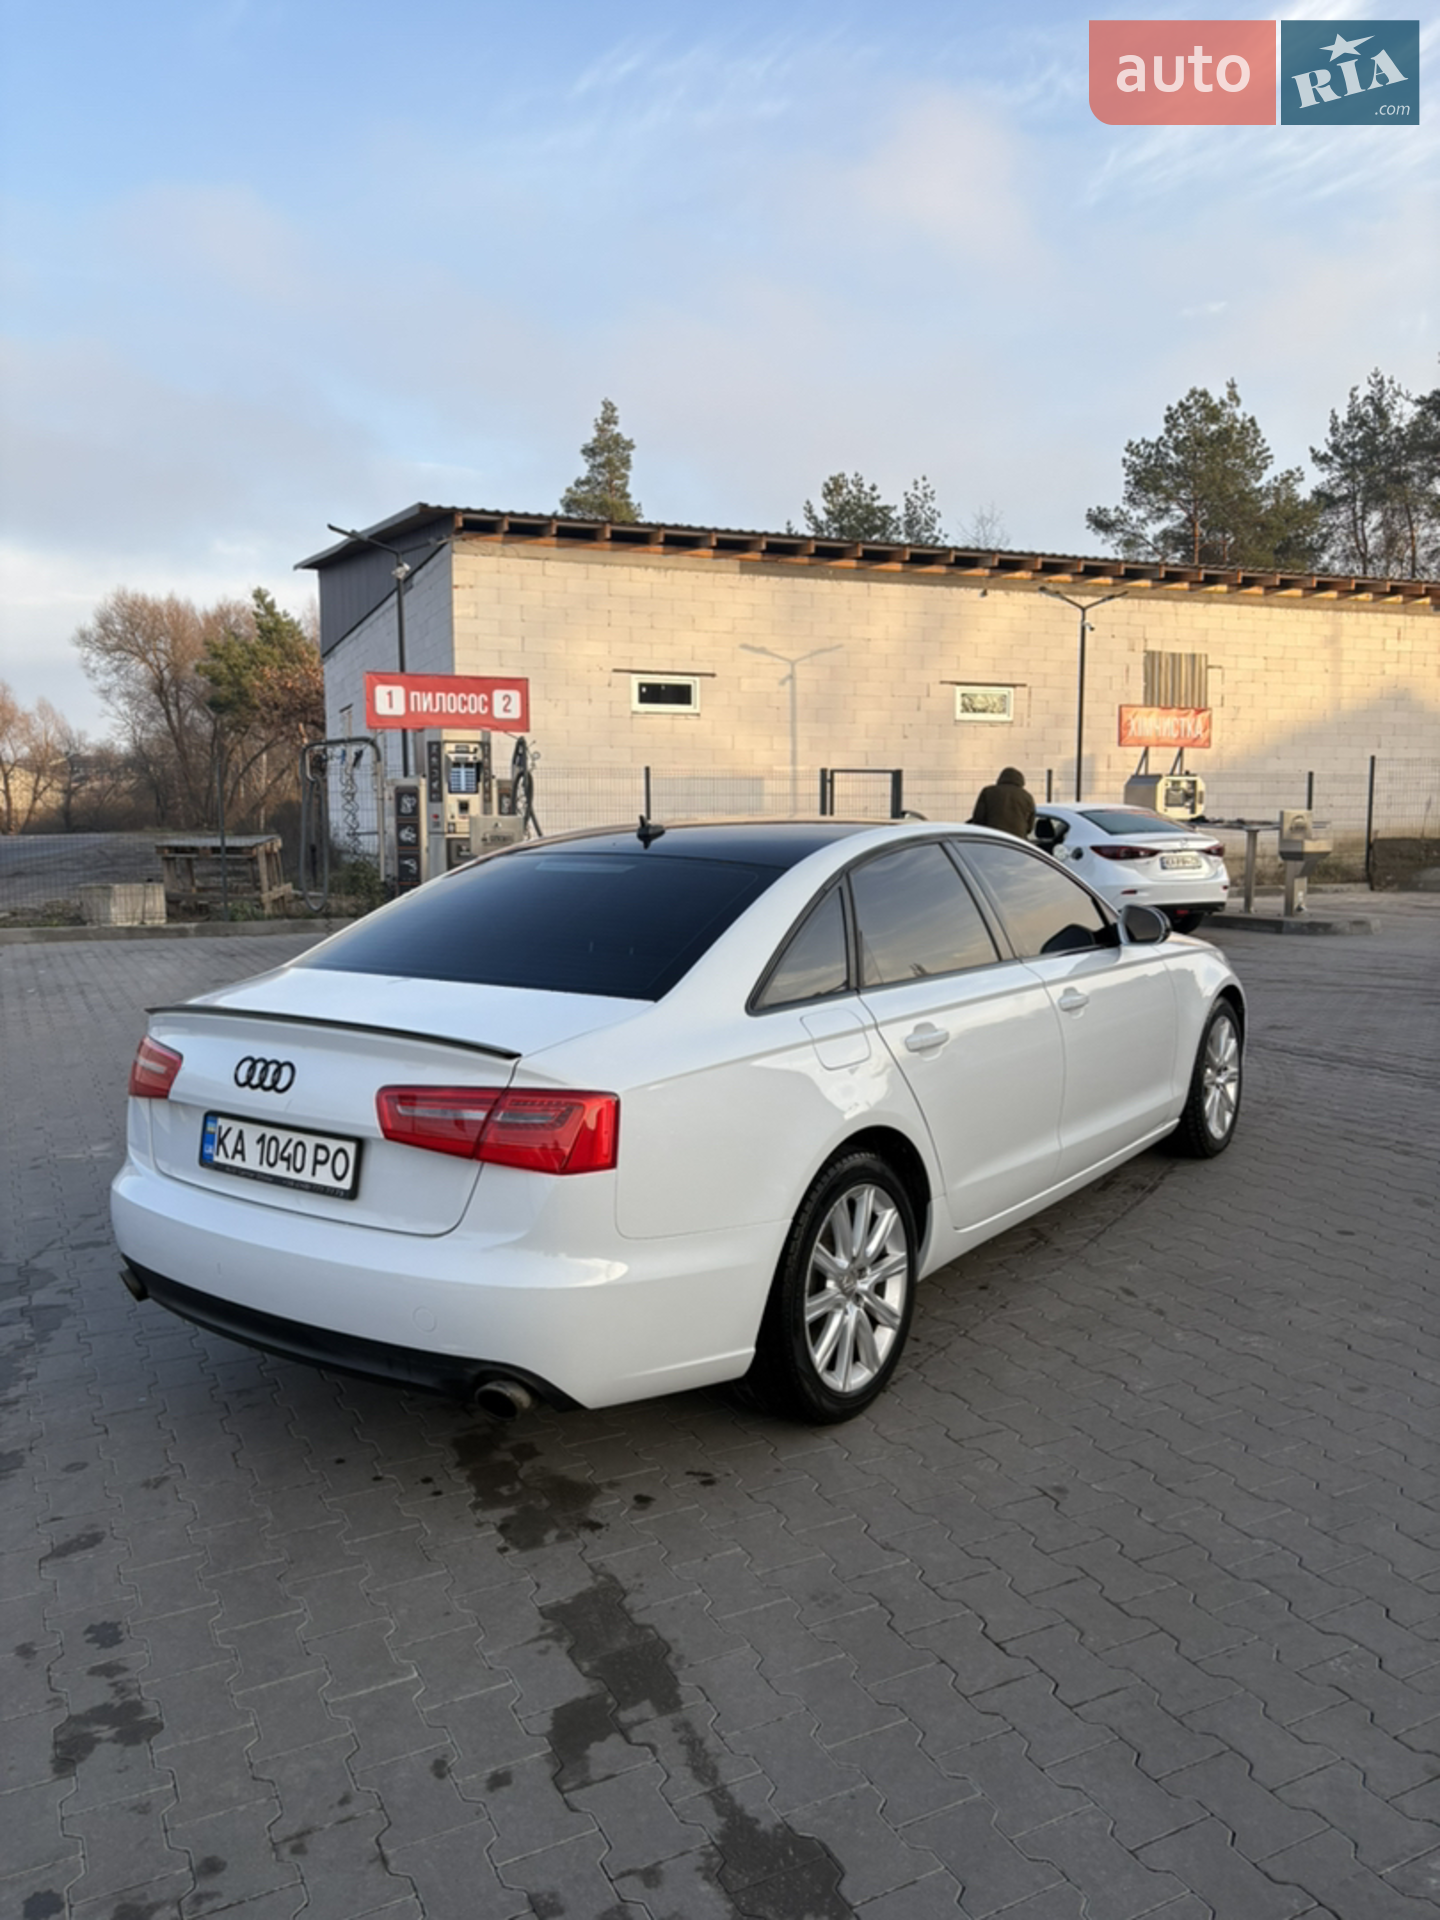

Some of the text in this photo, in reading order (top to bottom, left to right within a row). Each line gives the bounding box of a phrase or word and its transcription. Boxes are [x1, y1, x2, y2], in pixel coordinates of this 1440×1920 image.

[386, 690, 512, 715] 1 ПИЛОСОС 2
[215, 1125, 246, 1162] KA
[256, 1132, 307, 1174] 1040
[311, 1143, 350, 1182] PO
